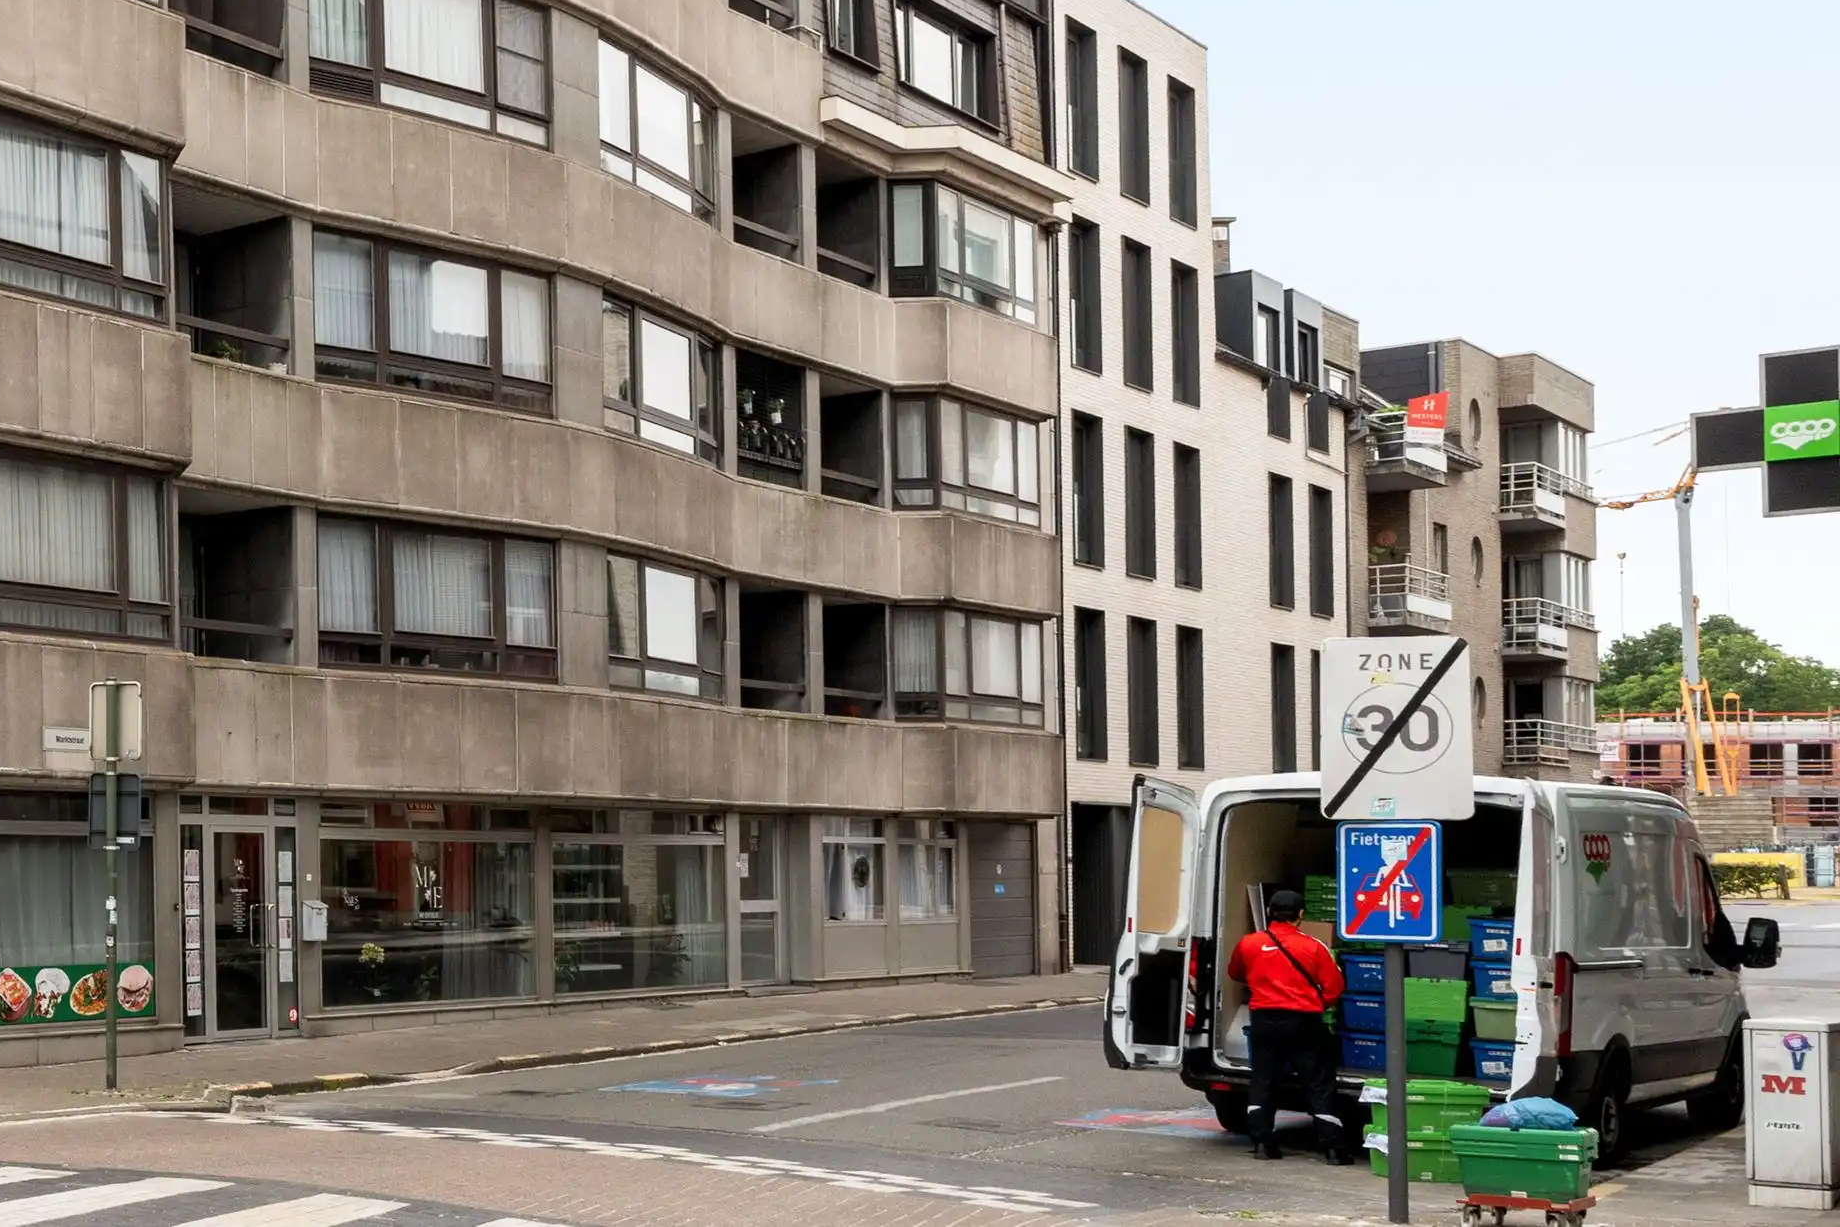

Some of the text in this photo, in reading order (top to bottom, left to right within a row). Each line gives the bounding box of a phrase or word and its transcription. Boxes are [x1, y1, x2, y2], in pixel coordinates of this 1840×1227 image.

[1770, 418, 1837, 441] coop
[1359, 653, 1433, 671] ZONE
[1356, 704, 1439, 752] 30
